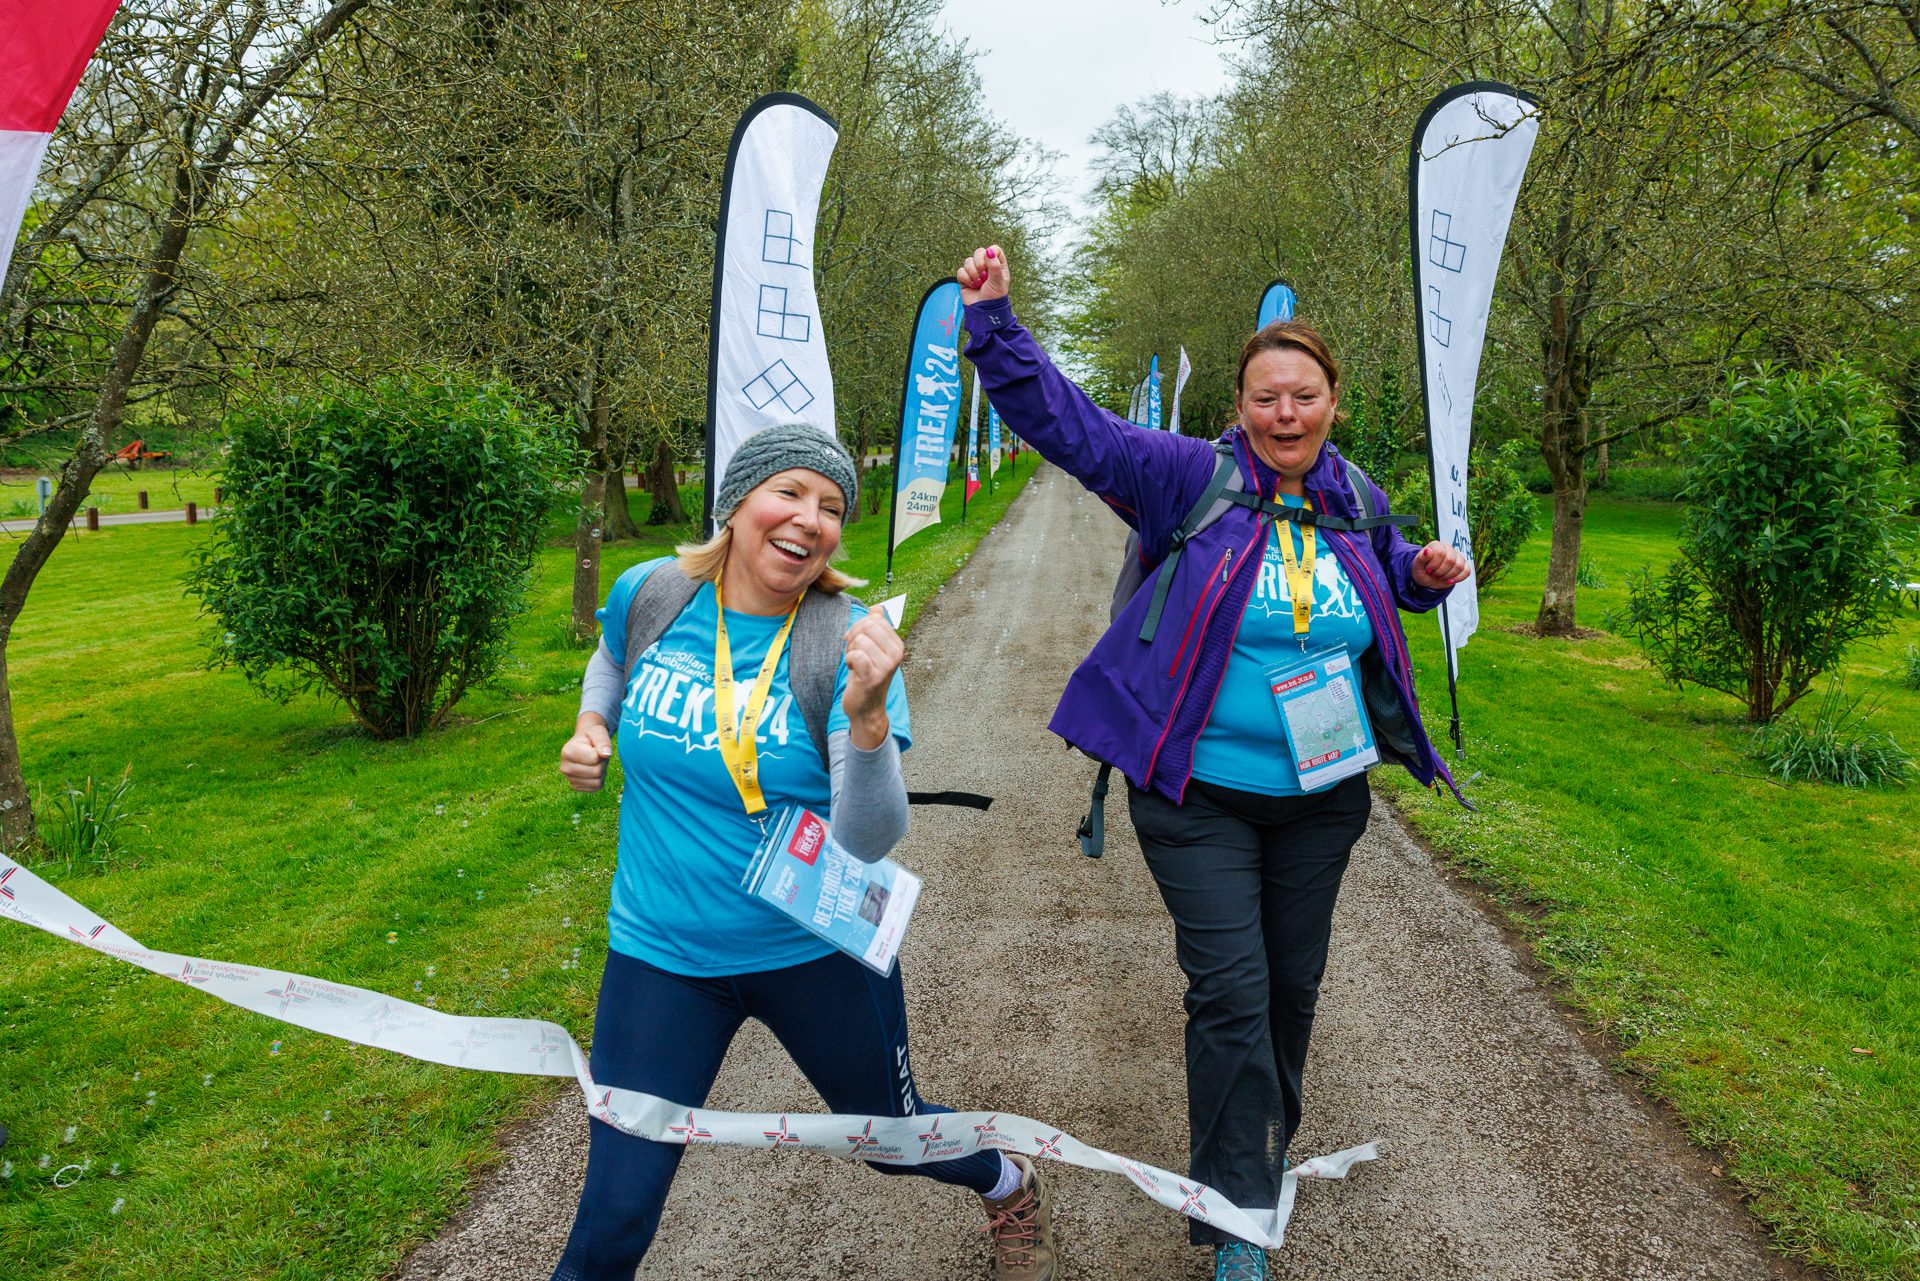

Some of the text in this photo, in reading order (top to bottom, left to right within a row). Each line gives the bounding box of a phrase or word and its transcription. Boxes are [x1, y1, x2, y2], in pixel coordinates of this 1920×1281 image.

[914, 343, 958, 468] TREK 24
[910, 491, 938, 502] 24km
[626, 663, 714, 733] TREK
[834, 886, 858, 923] TREK
[896, 1044, 917, 1116] RIAT
[862, 1144, 901, 1154] East Anglian
[868, 1153, 905, 1161] Ambulance
[930, 1141, 942, 1150] East
